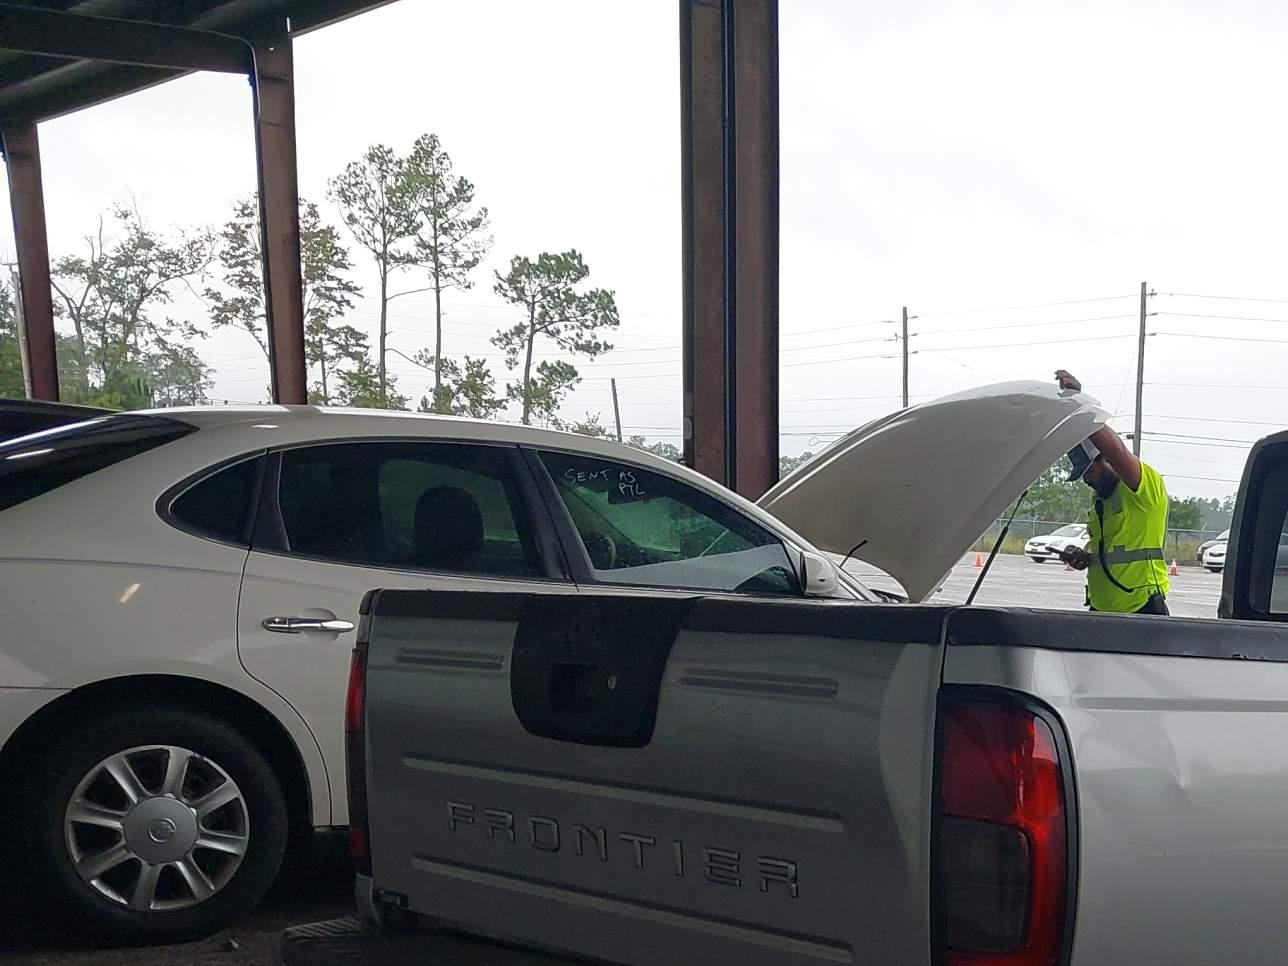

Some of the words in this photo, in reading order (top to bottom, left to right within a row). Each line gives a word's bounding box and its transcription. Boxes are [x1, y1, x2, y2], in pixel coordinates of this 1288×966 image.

[564, 468, 612, 485] SENT
[619, 471, 636, 484] AS
[618, 482, 646, 496] PTL
[447, 800, 800, 899] FRONTIER
